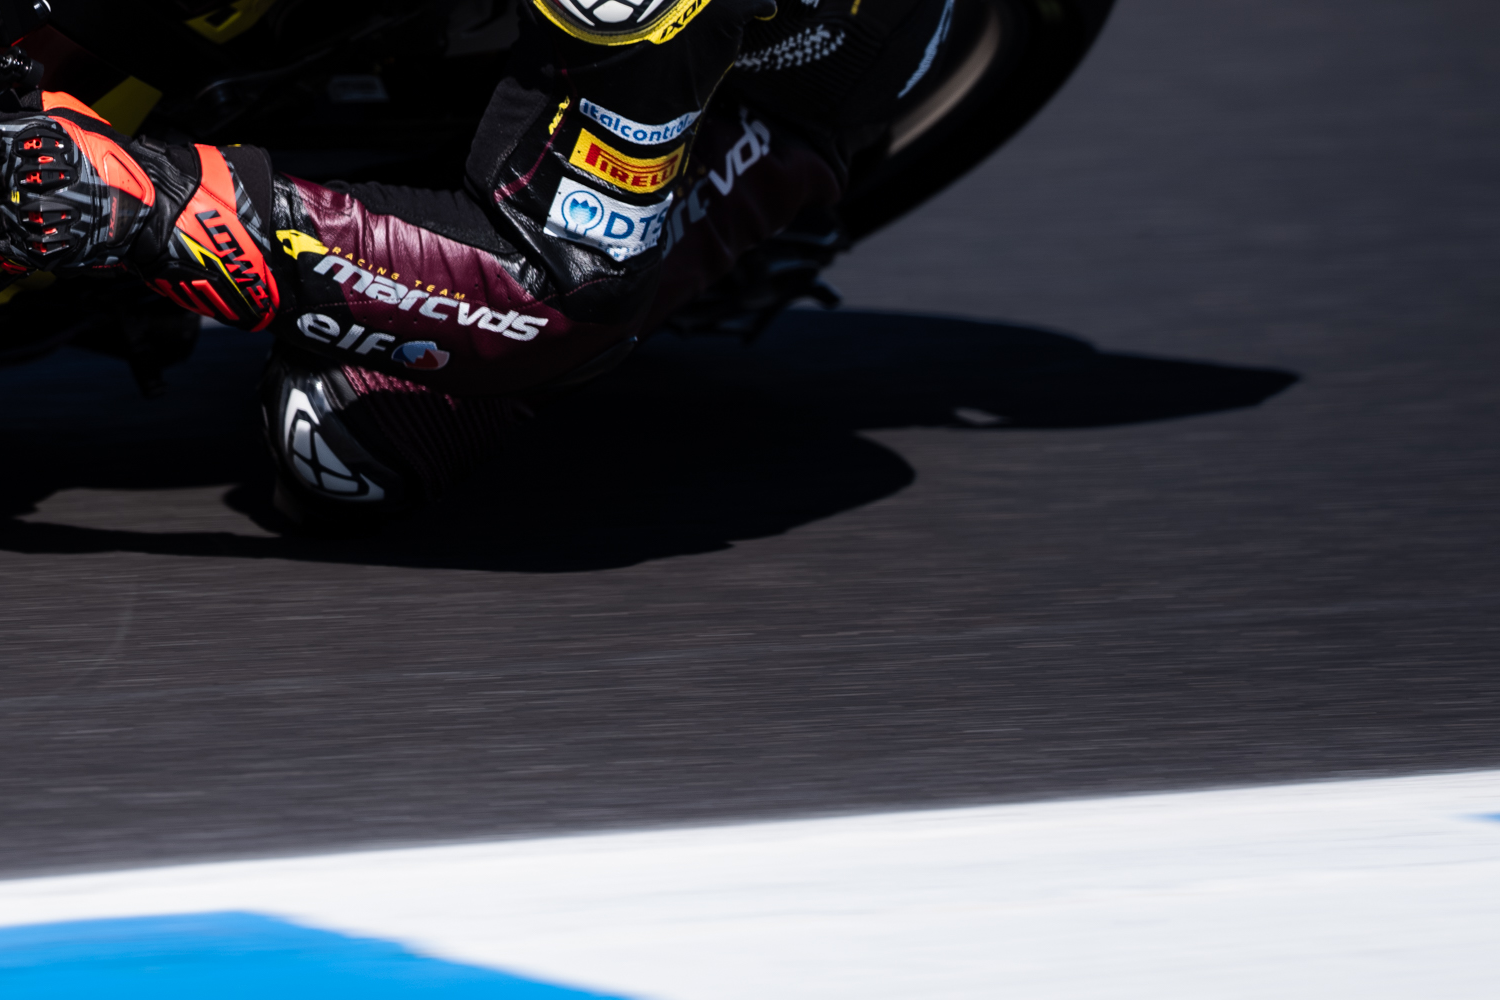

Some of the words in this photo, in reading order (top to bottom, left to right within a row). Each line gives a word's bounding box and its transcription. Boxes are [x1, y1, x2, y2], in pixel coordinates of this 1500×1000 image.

[585, 142, 679, 188] PIRELLI
[313, 254, 549, 342] marcvds
[331, 246, 400, 281] RACING
[414, 279, 466, 300] TEAM
[296, 312, 397, 355] elf
